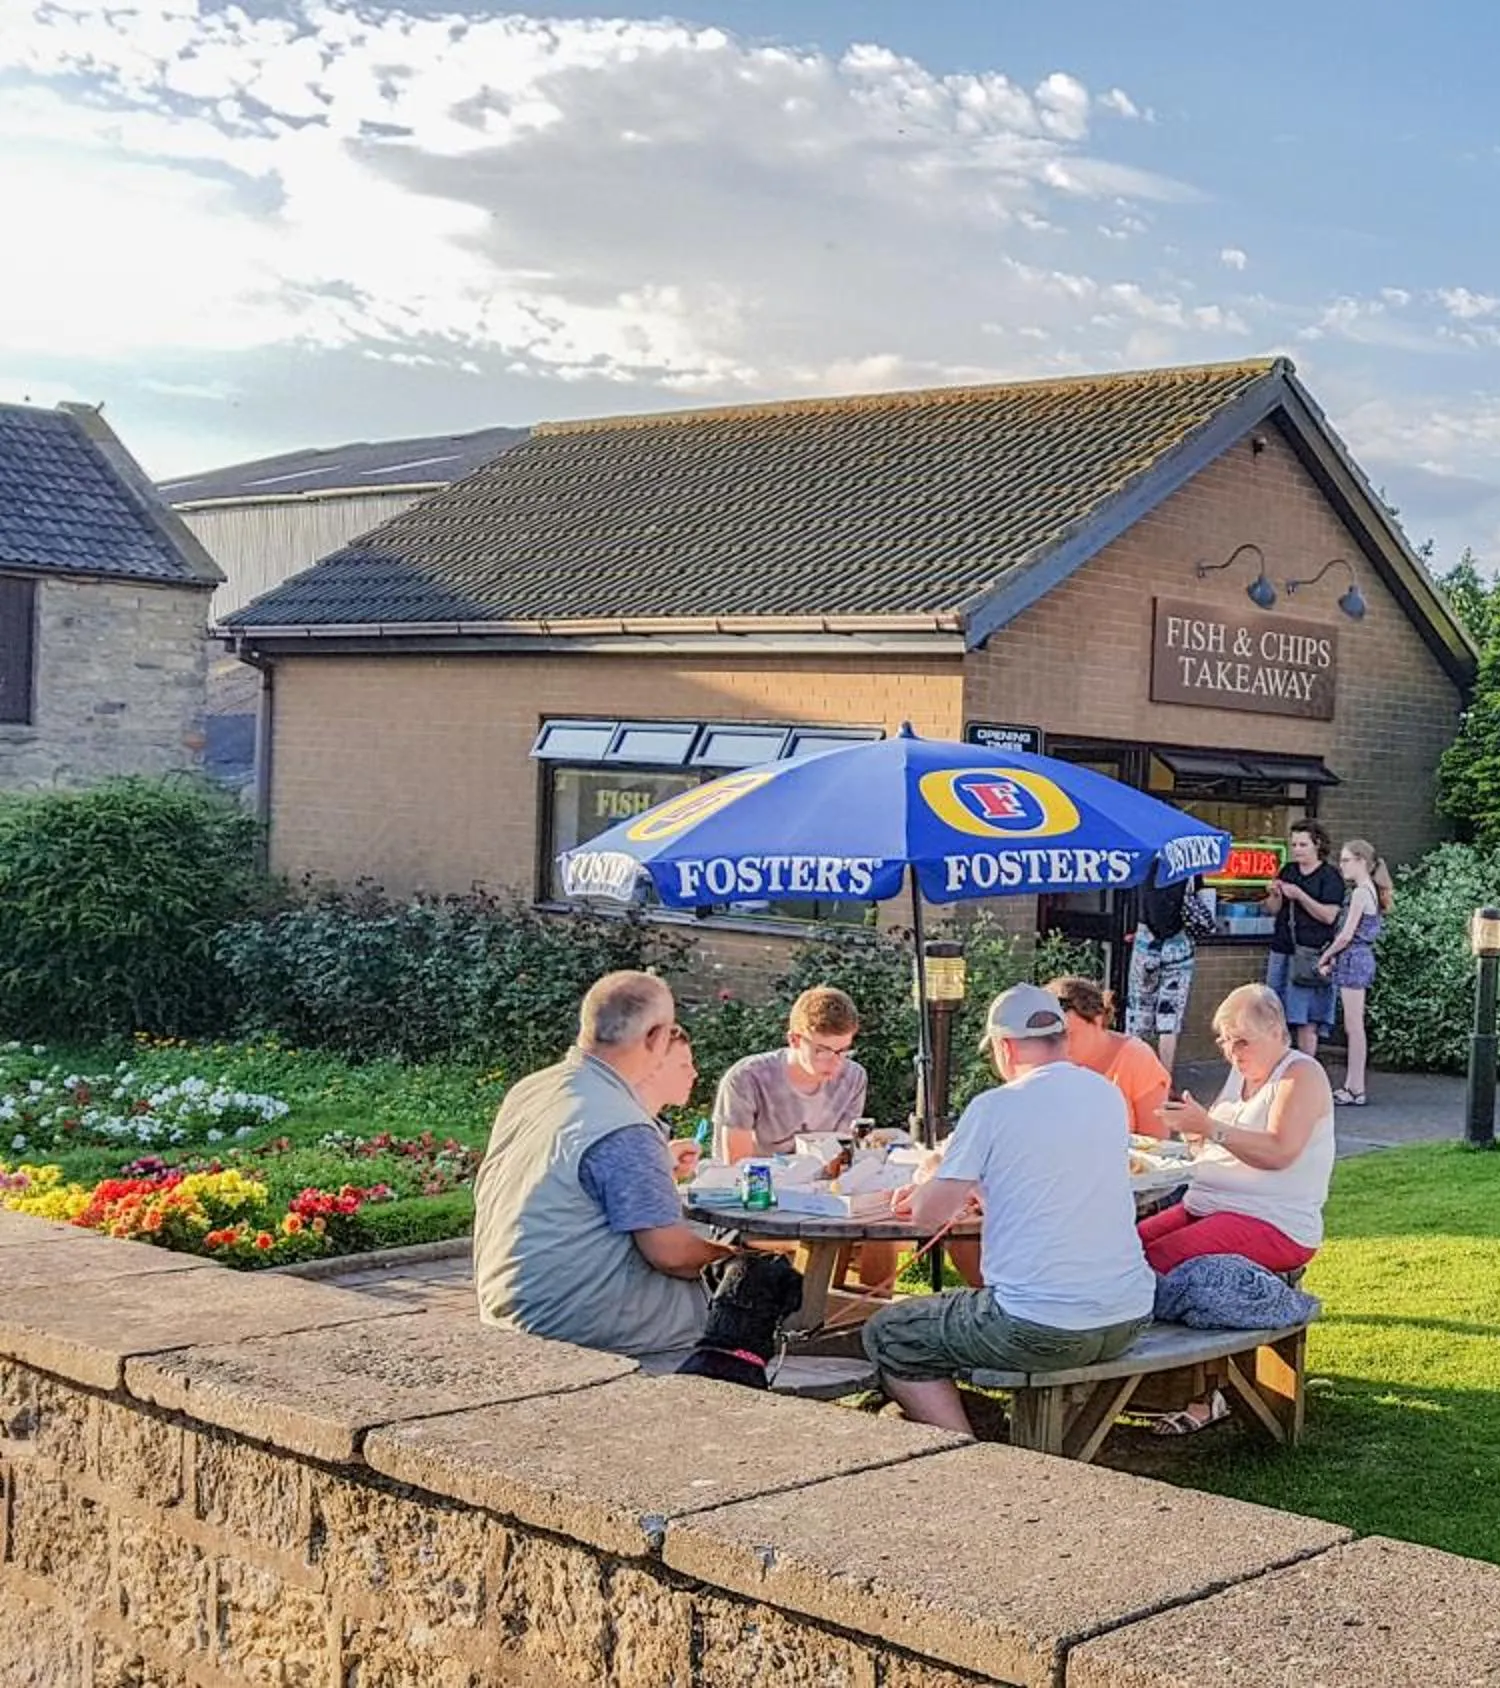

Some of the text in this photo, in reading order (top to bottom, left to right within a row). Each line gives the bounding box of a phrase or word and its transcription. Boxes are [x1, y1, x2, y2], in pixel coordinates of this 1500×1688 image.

[1166, 617, 1332, 669] FISH & CHIPS
[1178, 655, 1317, 701] TAKEAWAY
[977, 729, 1031, 743] OPENING
[595, 789, 650, 819] FISH
[961, 783, 1026, 818] F
[676, 856, 874, 898] FOSTER'S
[944, 850, 1132, 891] FOSTER'S
[1231, 850, 1277, 875] CHIPS
